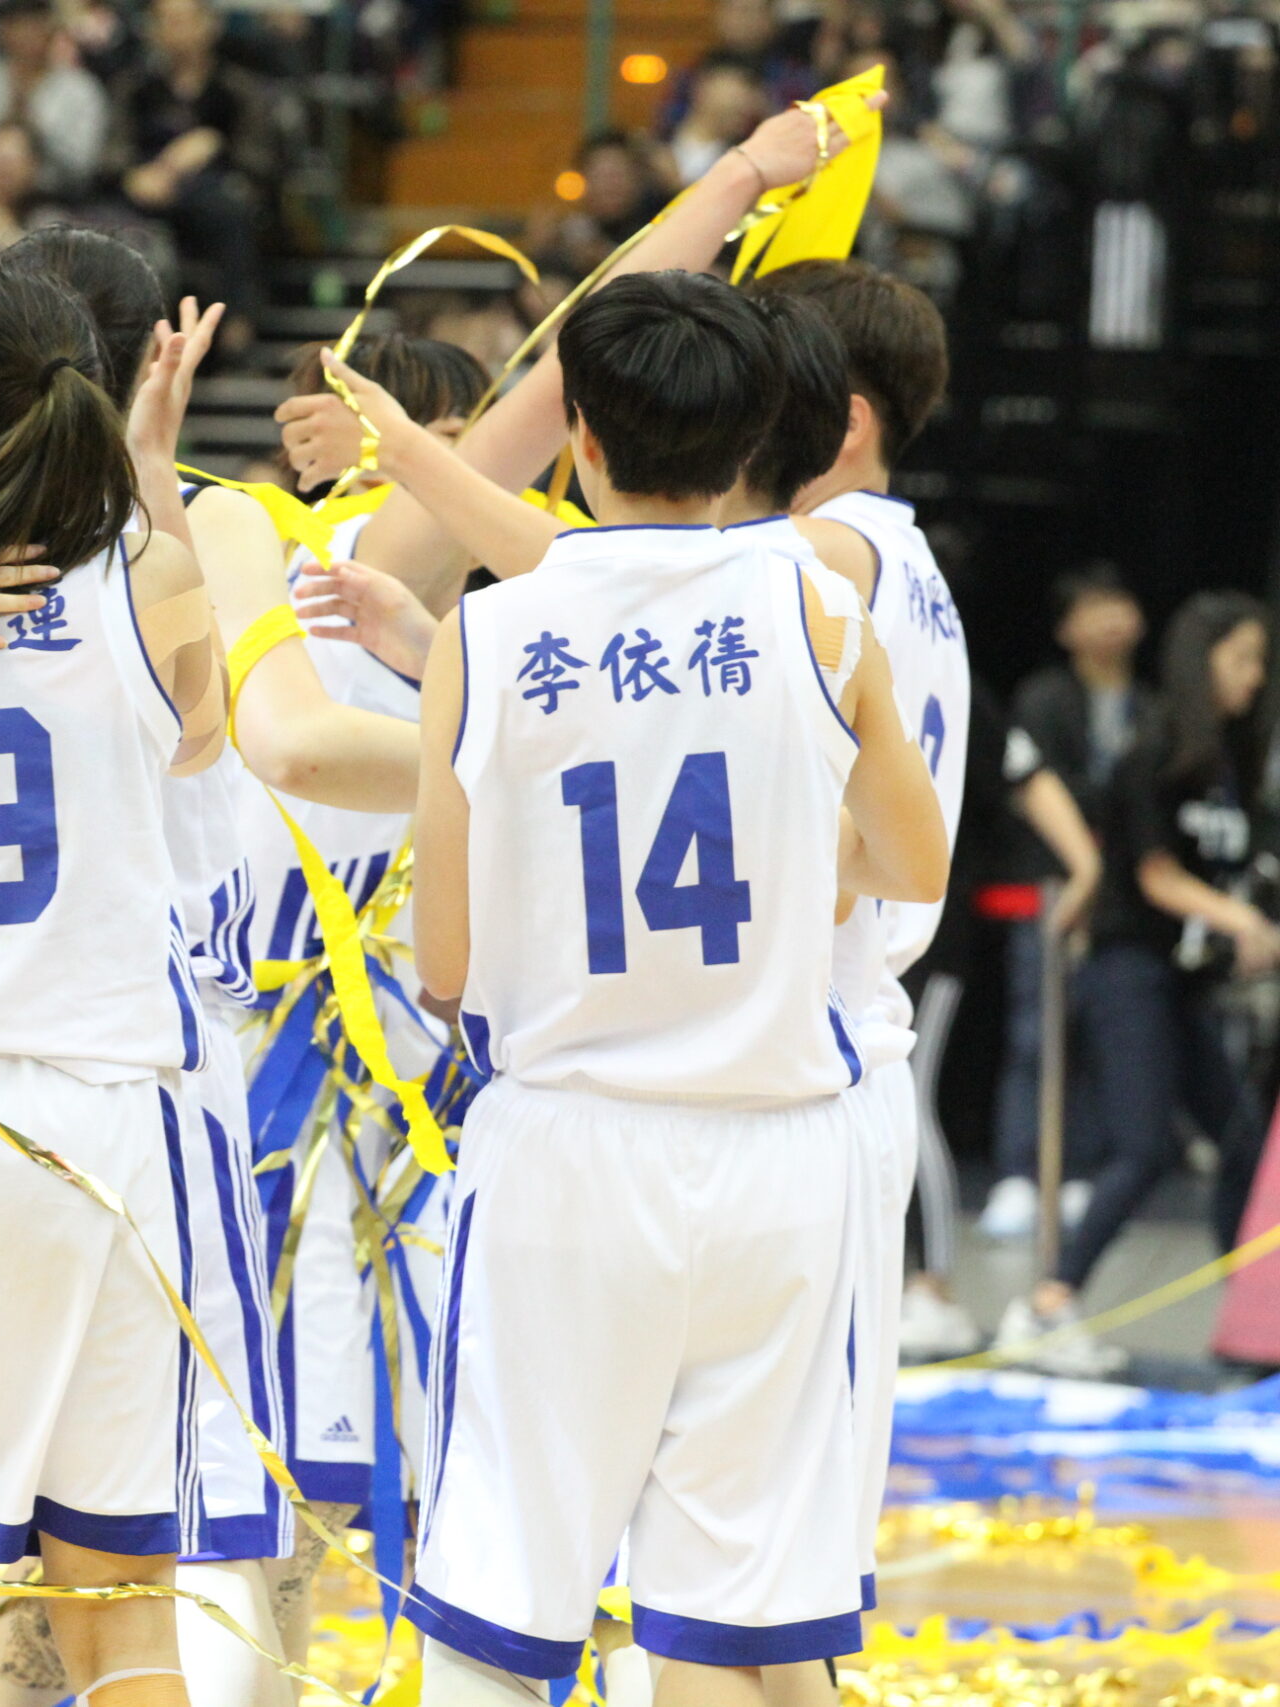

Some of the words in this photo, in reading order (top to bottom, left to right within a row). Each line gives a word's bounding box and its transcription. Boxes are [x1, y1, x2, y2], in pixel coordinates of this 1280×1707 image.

[516, 615, 760, 715] 李依蒨
[561, 751, 752, 975] 14
